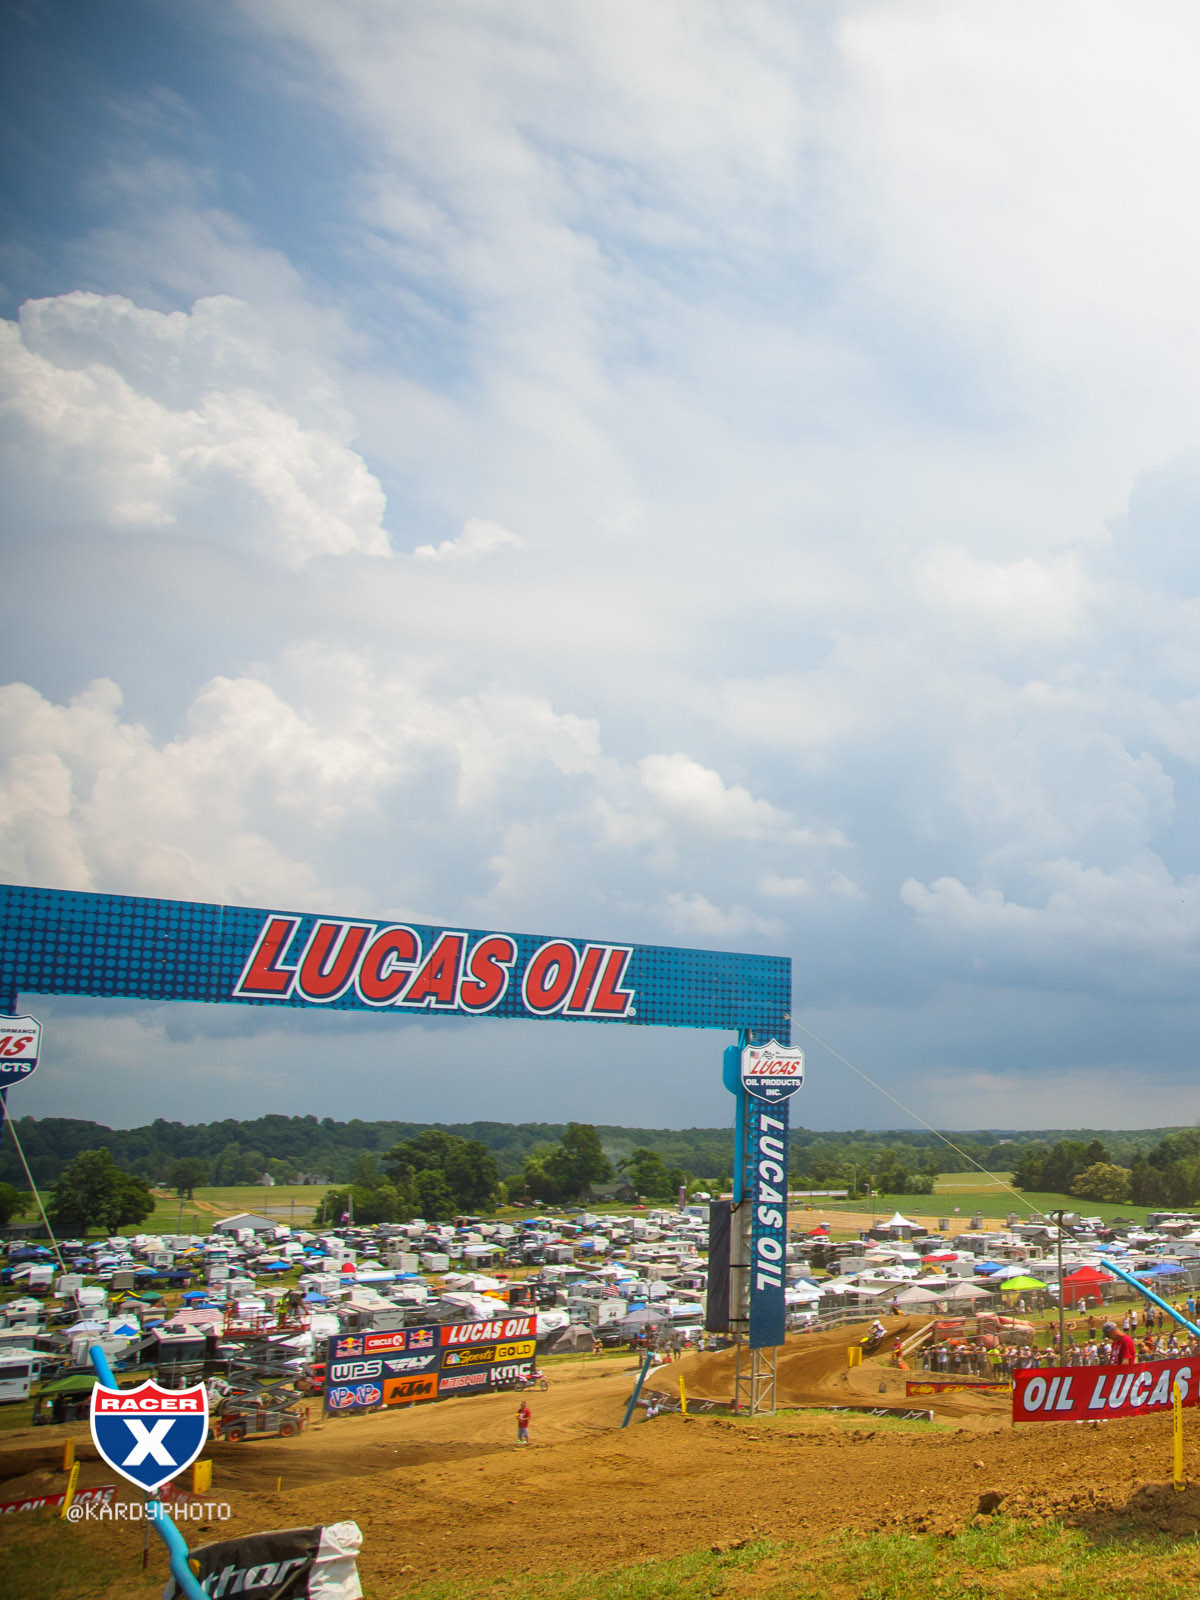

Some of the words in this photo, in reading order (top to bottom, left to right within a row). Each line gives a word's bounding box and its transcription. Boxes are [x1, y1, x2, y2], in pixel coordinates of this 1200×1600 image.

[232, 914, 518, 1014] LUCAS
[522, 939, 636, 1018] OIL
[0, 1062, 32, 1073] CTS
[749, 1061, 801, 1075] LUCAS
[761, 1078, 801, 1087] PRODUCTS
[765, 1088, 782, 1096] INC.
[757, 1114, 785, 1229] LUCAS
[756, 1237, 783, 1291] OIL
[448, 1320, 504, 1344] LUCAS
[505, 1317, 531, 1337] OIL
[368, 1338, 392, 1347] CIRCLE
[383, 1354, 437, 1370] FLY
[459, 1349, 495, 1365] Sports
[498, 1344, 531, 1357] GOLD
[331, 1360, 383, 1382] WPS
[390, 1380, 433, 1399] KTM
[1023, 1376, 1074, 1412] OIL
[1088, 1366, 1192, 1410] LUCAS
